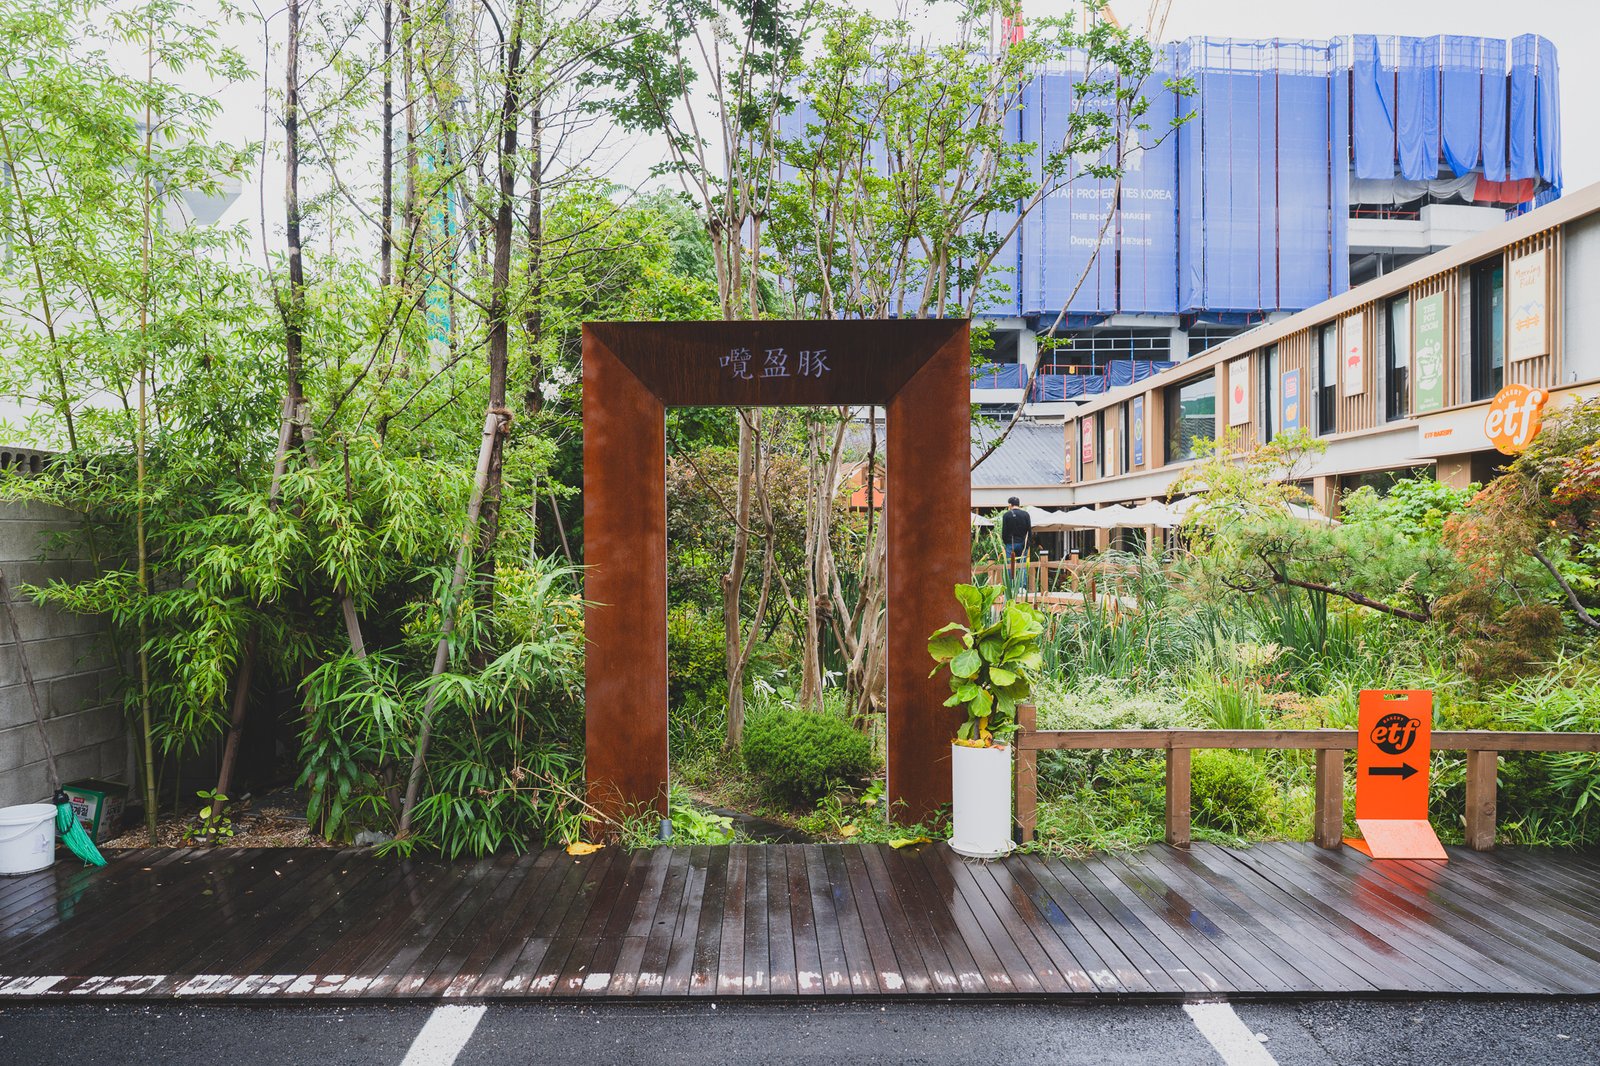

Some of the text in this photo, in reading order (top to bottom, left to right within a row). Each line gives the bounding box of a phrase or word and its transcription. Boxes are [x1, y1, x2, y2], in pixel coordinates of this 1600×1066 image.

[1049, 188, 1073, 199] STAR
[1141, 188, 1172, 200] KOREA
[1423, 312, 1436, 323] POT
[1497, 389, 1523, 404] BAKERY
[1485, 390, 1542, 446] etf
[1383, 715, 1404, 724] BAKERY
[1371, 719, 1420, 751] etf
[72, 805, 89, 817] 계절
